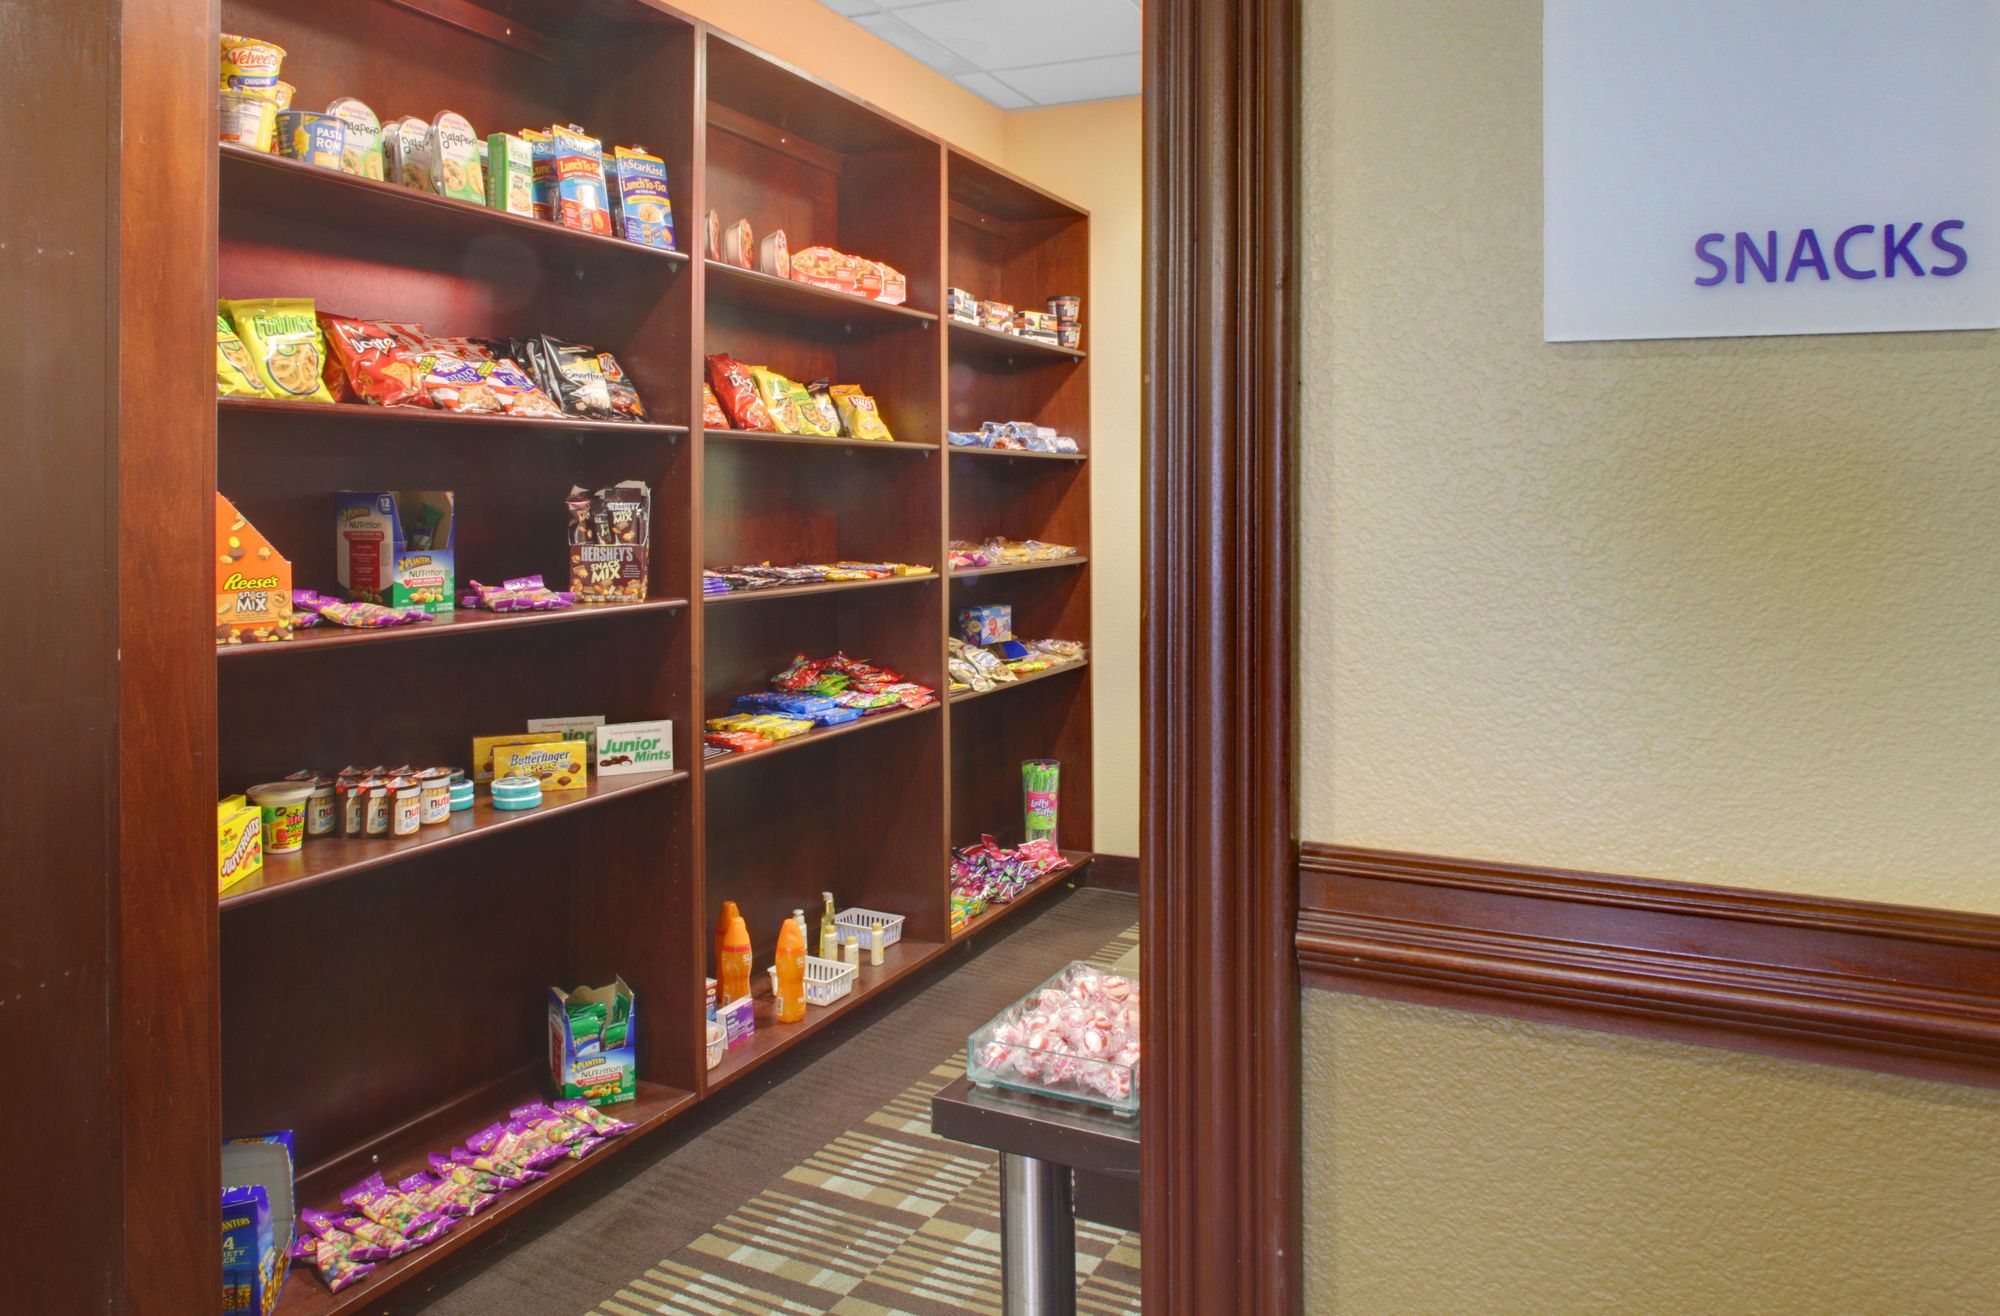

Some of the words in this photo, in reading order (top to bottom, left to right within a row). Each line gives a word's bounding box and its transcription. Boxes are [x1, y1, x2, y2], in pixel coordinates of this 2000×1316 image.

[627, 159, 664, 177] StarKist
[1694, 219, 1969, 287] SNACKS
[379, 497, 392, 508] 12
[580, 546, 634, 562] HERSHEY'S
[404, 556, 432, 569] PLANTERS
[590, 559, 621, 572] SNACK
[223, 572, 279, 591] Reese's
[591, 567, 622, 584] MIX
[599, 735, 661, 756] Junior
[510, 750, 570, 767] Butterfinger
[634, 749, 671, 763] Mints
[523, 762, 558, 776] Bites
[223, 1236, 235, 1250] 4
